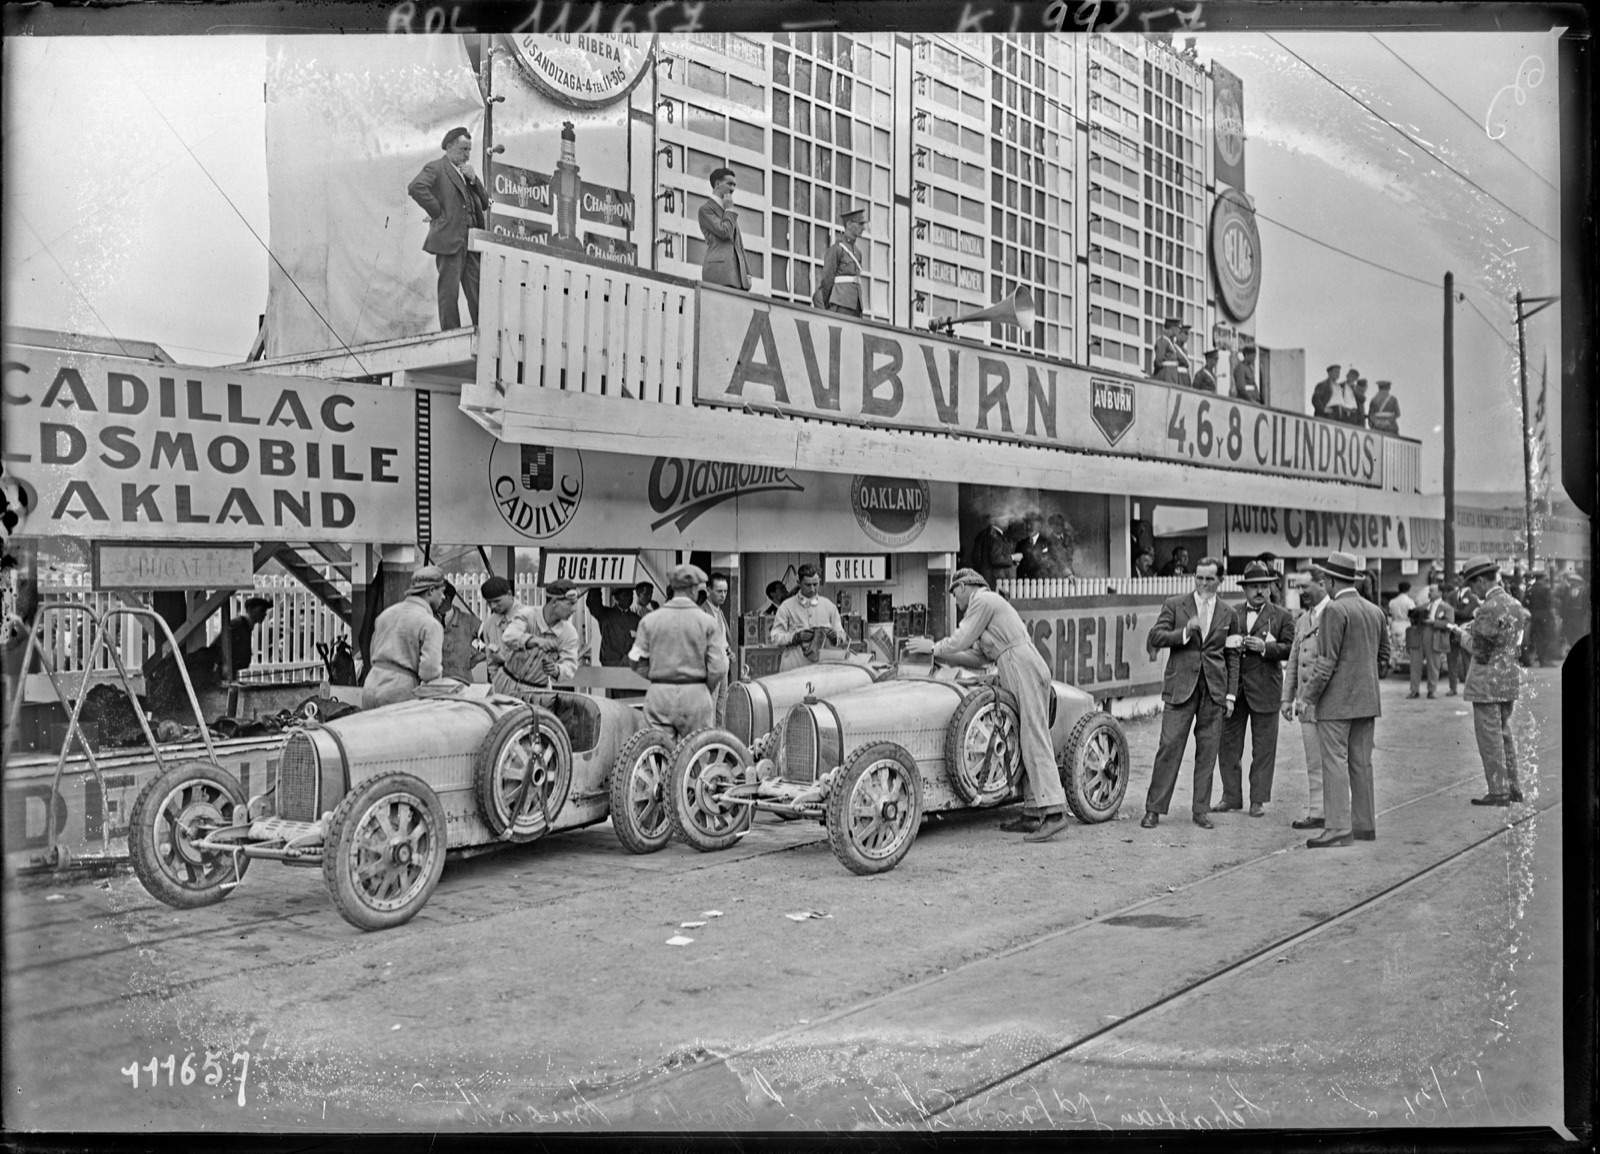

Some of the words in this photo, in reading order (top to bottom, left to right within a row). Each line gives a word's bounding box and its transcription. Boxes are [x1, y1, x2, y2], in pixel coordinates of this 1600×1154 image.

[578, 34, 621, 63] RIBERA
[495, 174, 550, 206] CHAMPION
[583, 192, 632, 221] CHAMPION
[2, 361, 356, 434] CADILLAC
[1226, 406, 1243, 462] 8
[1253, 412, 1375, 481] CILINDROS
[495, 474, 581, 535] CADILLAC
[860, 486, 923, 511] OAKLAND
[557, 556, 626, 580] BUGATTI
[835, 559, 875, 579] SHELL
